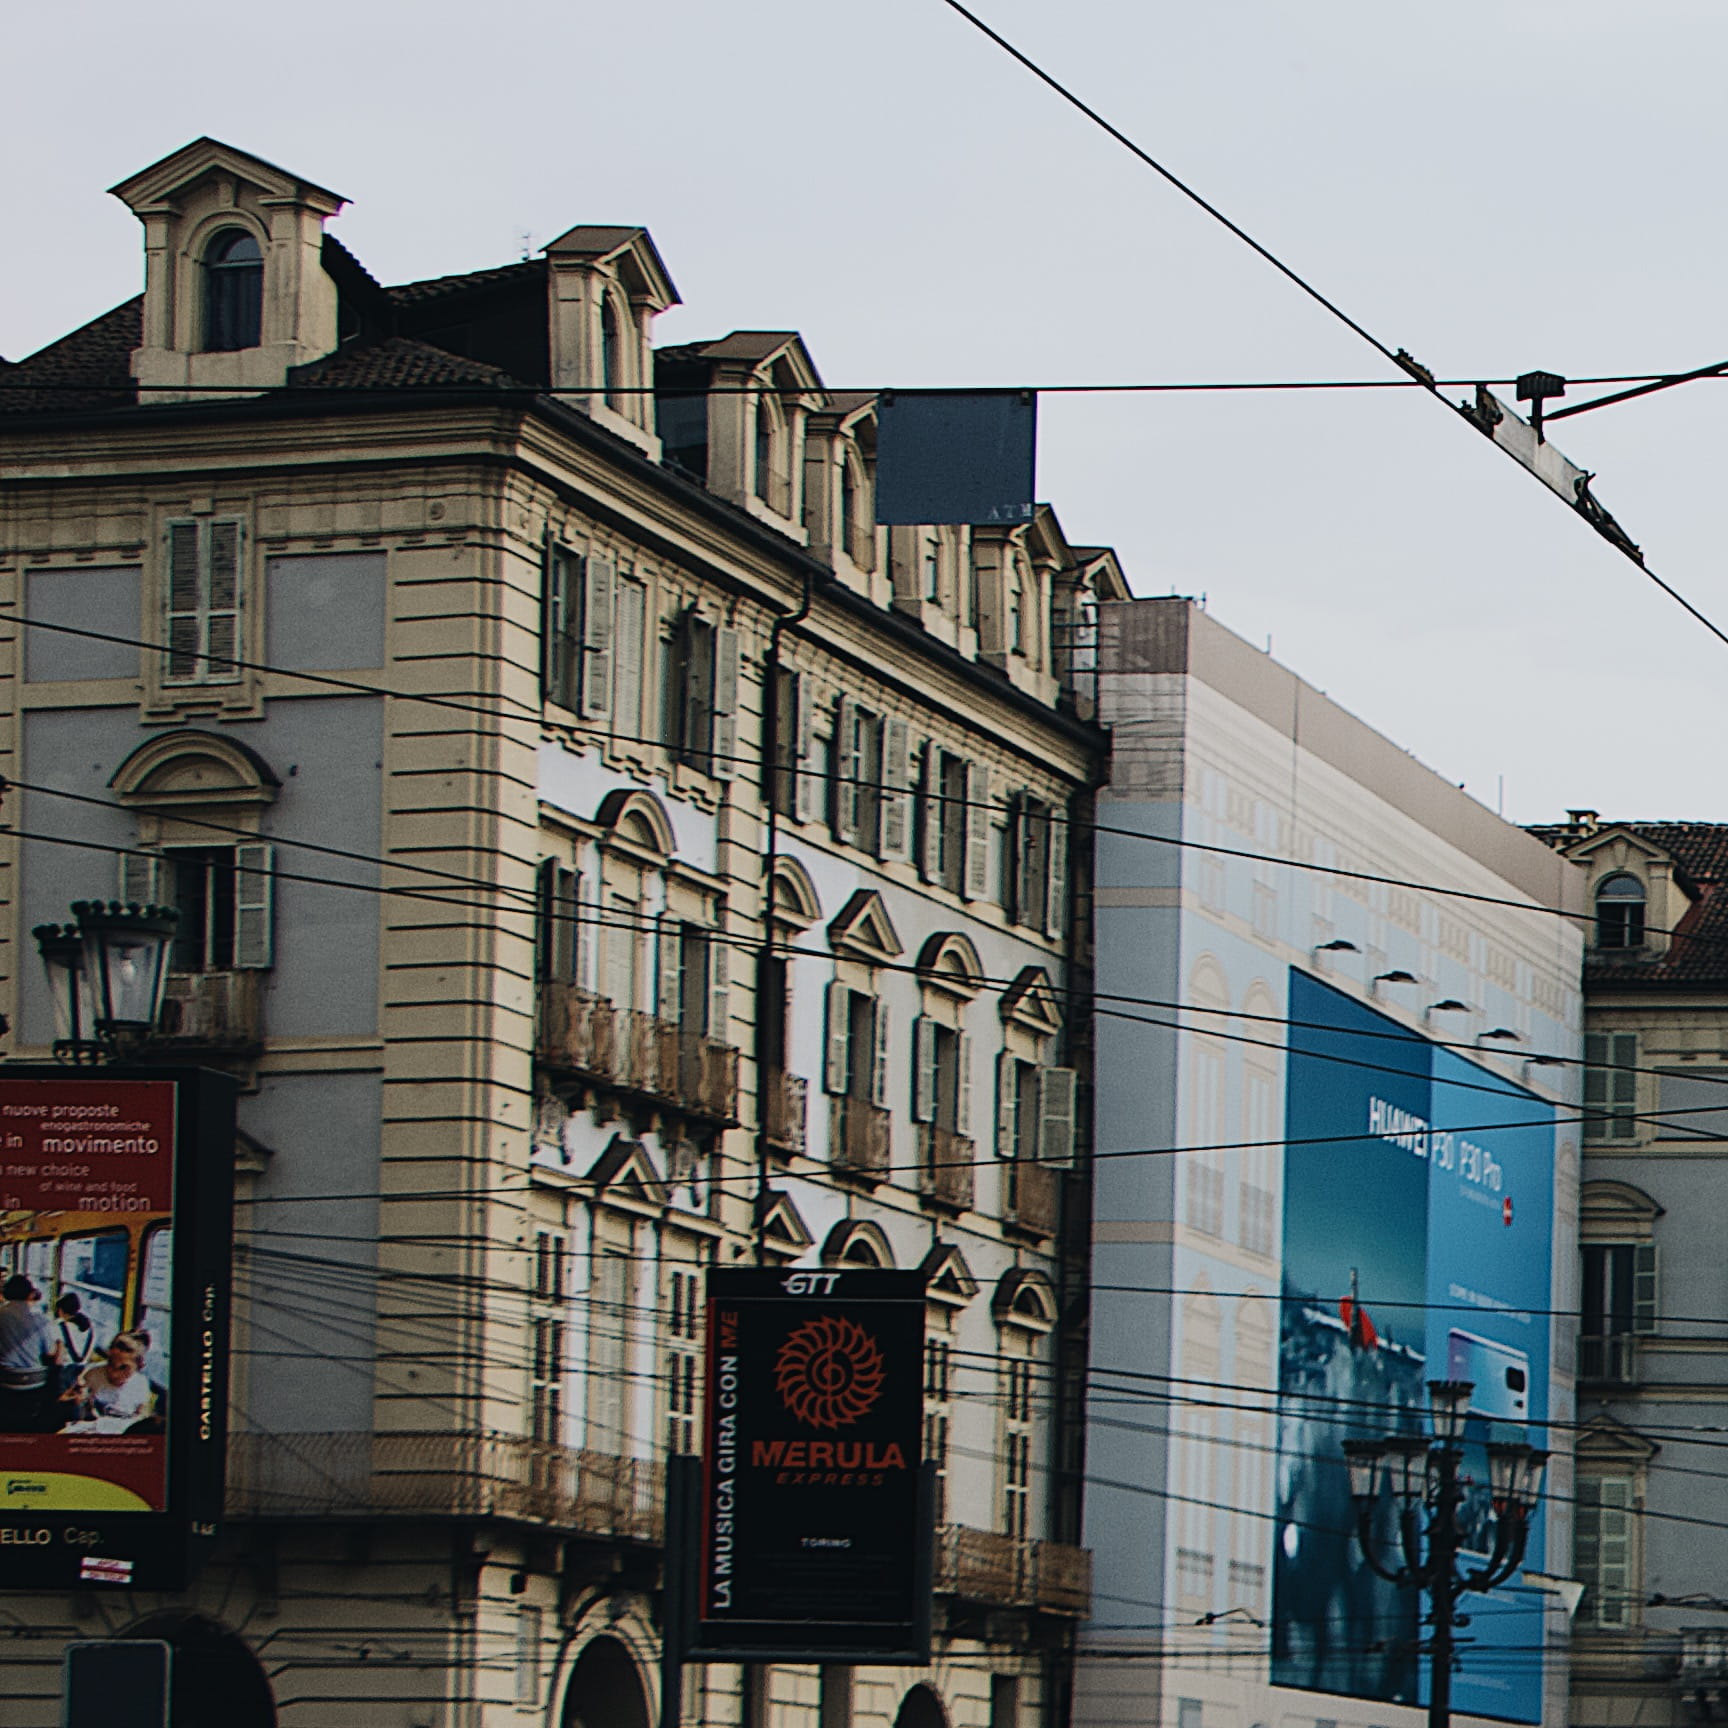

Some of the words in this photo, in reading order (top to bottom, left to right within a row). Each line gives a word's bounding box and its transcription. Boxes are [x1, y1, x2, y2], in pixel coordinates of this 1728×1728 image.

[3, 1104, 49, 1117] nuove
[52, 1104, 120, 1119] proposte
[6, 1134, 24, 1149] in
[42, 1135, 160, 1154] movimento
[1369, 1096, 1428, 1158] HUAWEI
[1431, 1126, 1454, 1171] P30
[1460, 1140, 1482, 1183] P30
[1483, 1152, 1503, 1192] Pro
[7, 1165, 37, 1176] new
[41, 1163, 91, 1177] choice
[4, 1193, 21, 1209] in
[79, 1193, 152, 1211] motion
[780, 1273, 840, 1296] GTT
[719, 1311, 739, 1348] ME
[200, 1329, 215, 1442] CASTELLO
[717, 1356, 739, 1409] CON
[716, 1416, 738, 1473] GIRA
[751, 1440, 907, 1470] MERULA
[776, 1472, 886, 1487] EXPRESS
[63, 1526, 105, 1549] Cap.
[714, 1477, 737, 1575] MUSICA
[713, 1580, 733, 1609] LA
